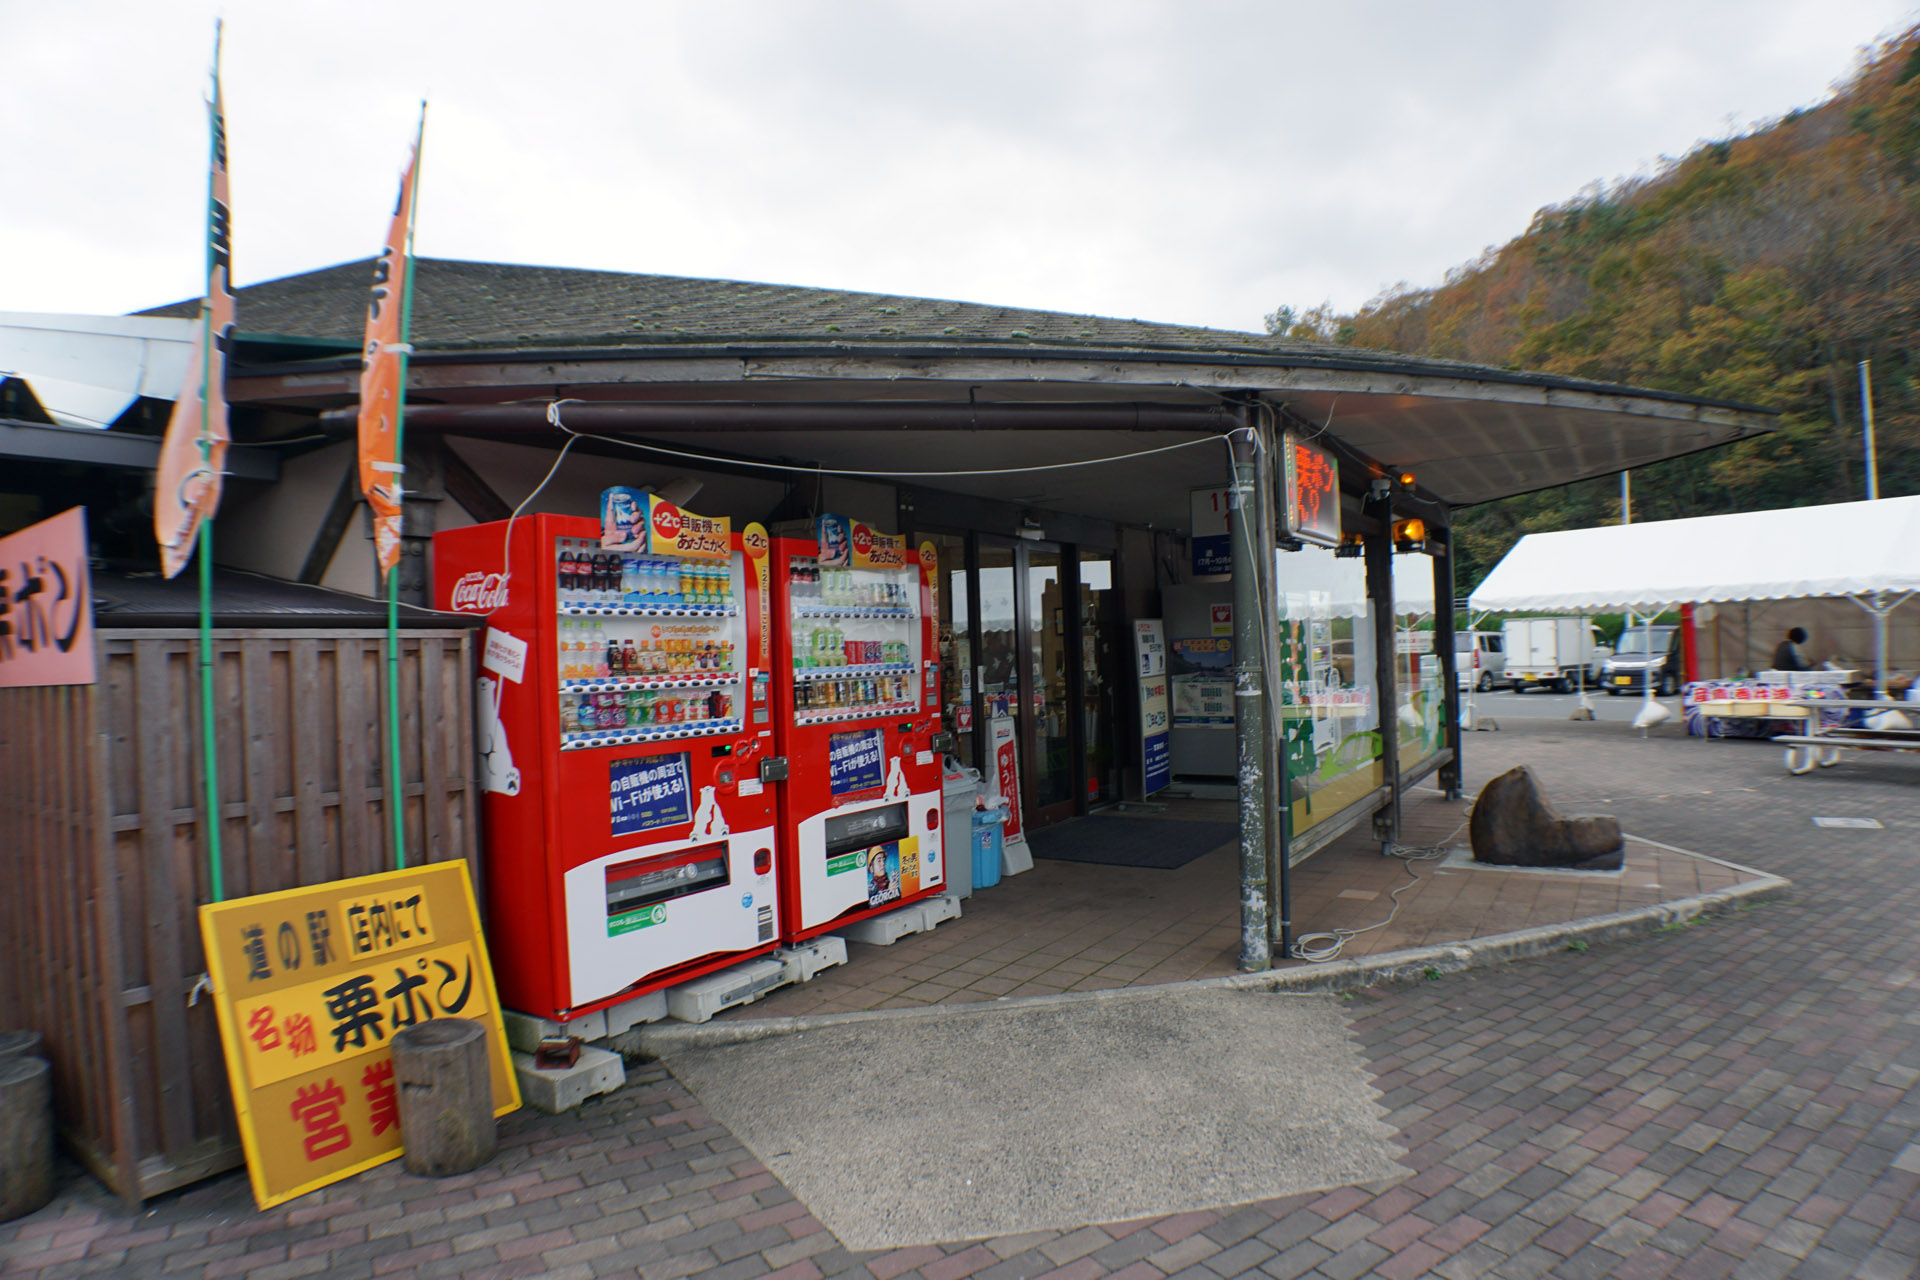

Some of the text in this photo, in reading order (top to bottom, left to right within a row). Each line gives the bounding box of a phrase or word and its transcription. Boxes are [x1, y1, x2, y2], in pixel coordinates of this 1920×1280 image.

[241, 894, 428, 982] 道の駅 店内にて
[869, 888, 900, 906] GEORGIA
[246, 953, 473, 1058] 名物 栗ポン
